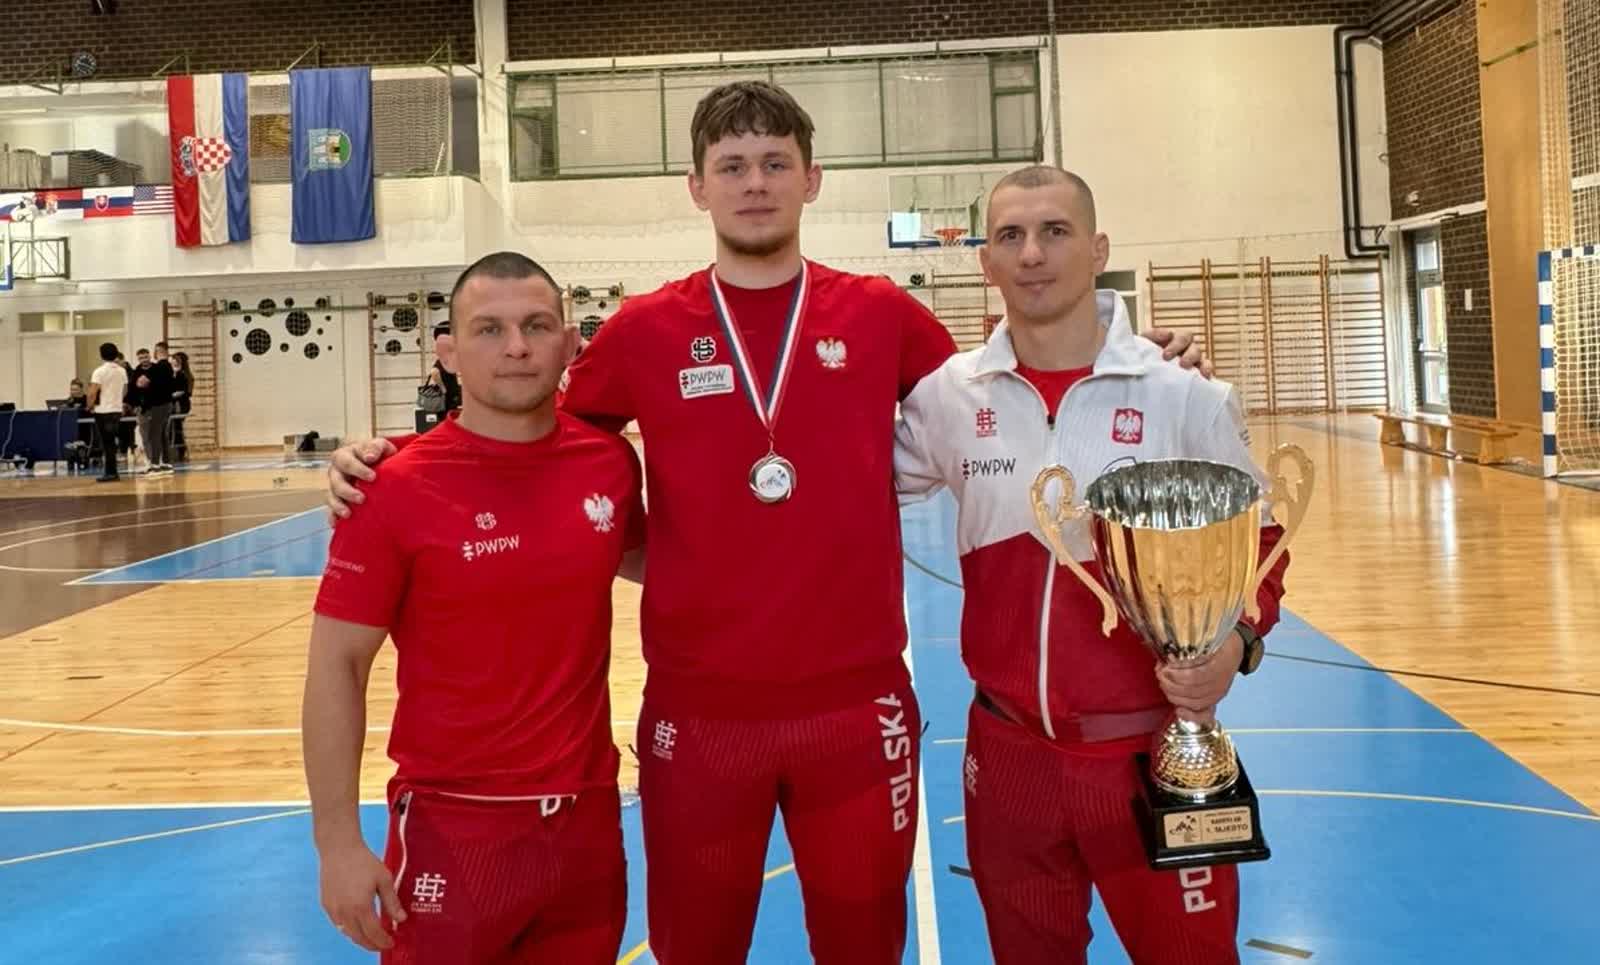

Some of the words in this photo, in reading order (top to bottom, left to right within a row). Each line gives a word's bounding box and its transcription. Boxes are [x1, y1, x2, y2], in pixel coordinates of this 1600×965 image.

[690, 368, 727, 384] PWPW
[972, 458, 1016, 477] PWPW
[475, 535, 519, 557] PWPW
